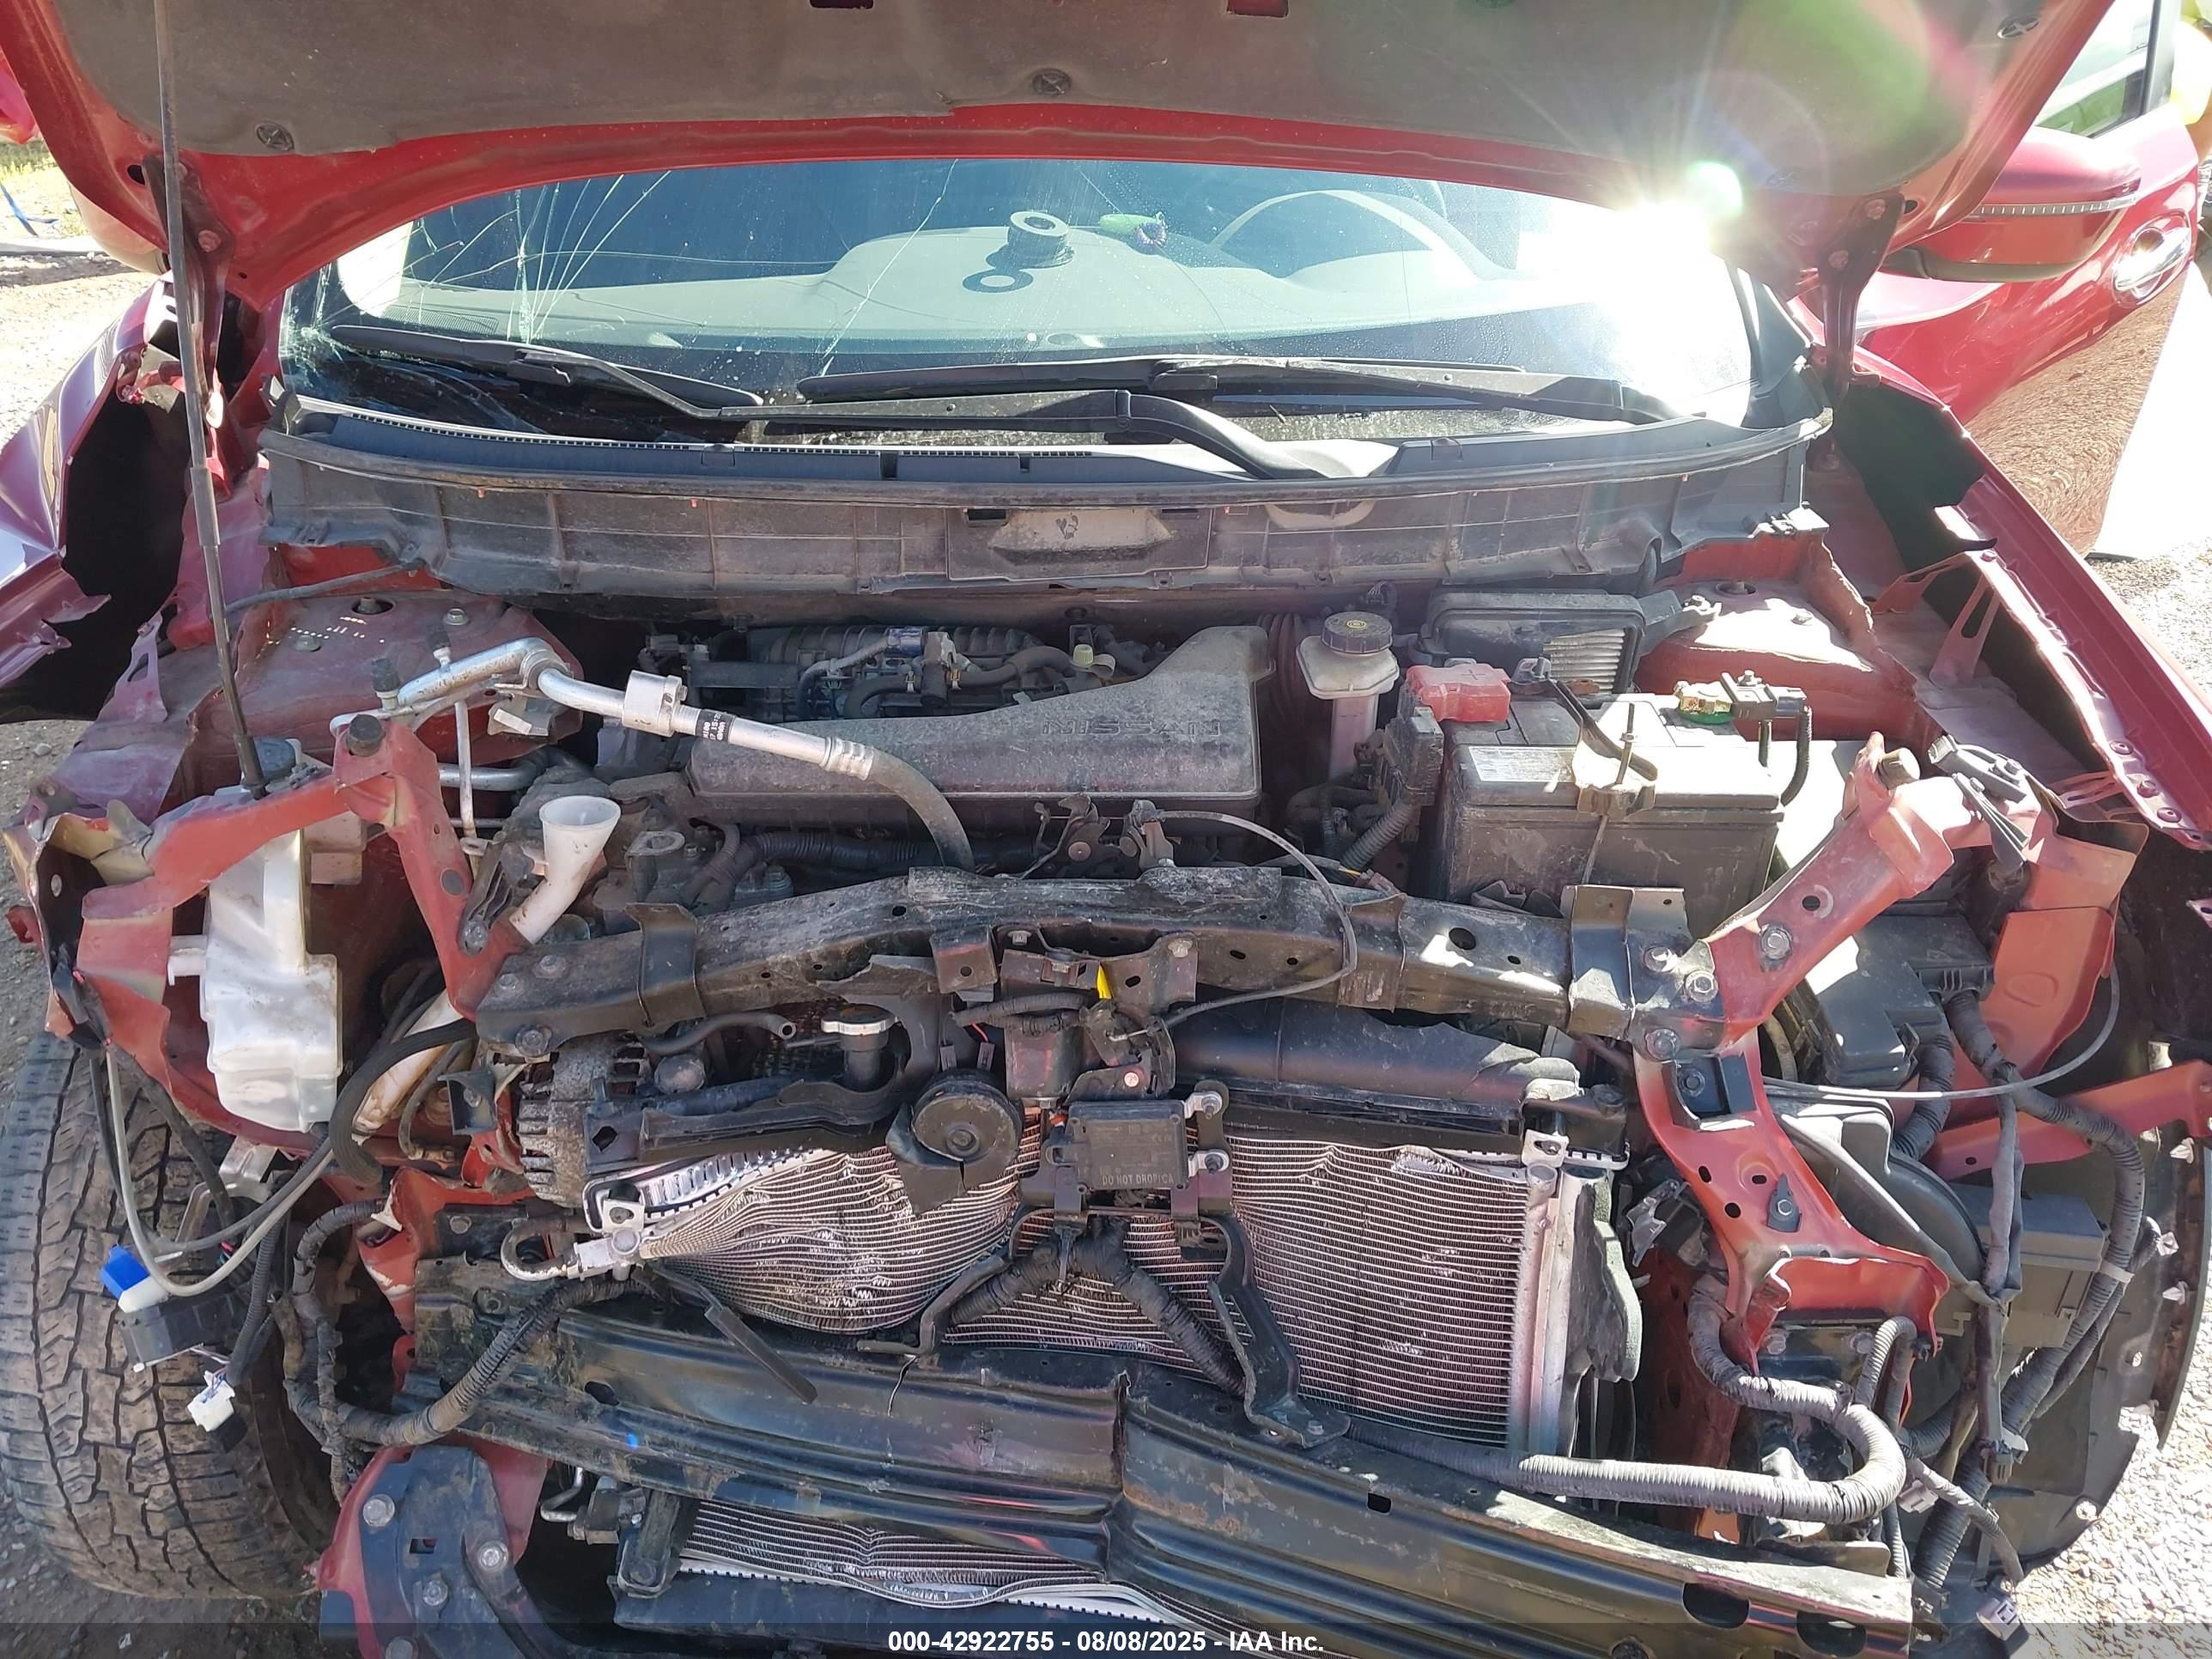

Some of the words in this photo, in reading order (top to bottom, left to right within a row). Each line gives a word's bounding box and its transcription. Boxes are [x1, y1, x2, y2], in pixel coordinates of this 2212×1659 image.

[1042, 720, 1220, 736] NISSAN
[1102, 1174, 1114, 1185] DO
[1116, 1174, 1133, 1185] NOT
